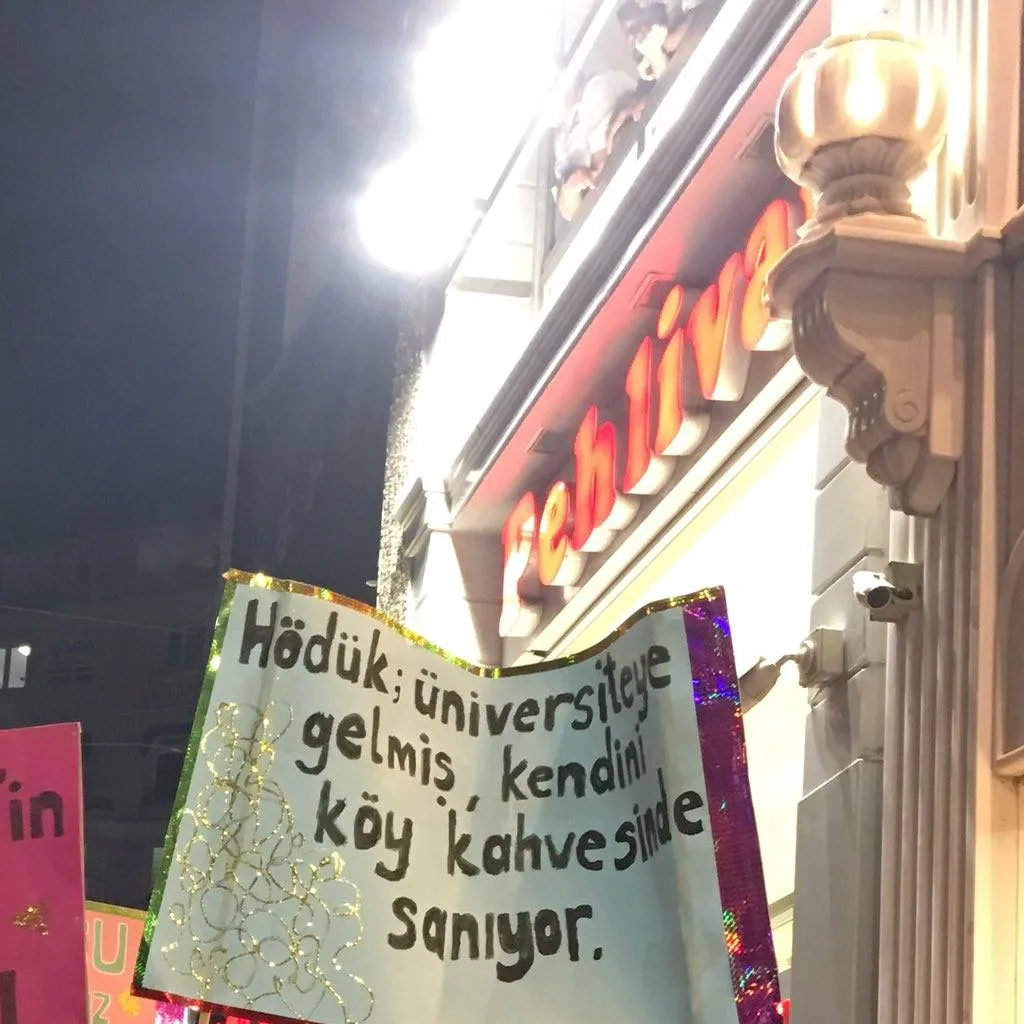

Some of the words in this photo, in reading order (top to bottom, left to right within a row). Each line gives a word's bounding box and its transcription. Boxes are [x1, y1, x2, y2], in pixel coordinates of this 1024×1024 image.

[500, 187, 814, 636] Pehliva
[416, 642, 672, 739] üniversiteye
[502, 723, 648, 802] kendini
[314, 780, 414, 882] köy
[447, 767, 704, 878] kahvesinde
[387, 896, 604, 983] sanıyor.
